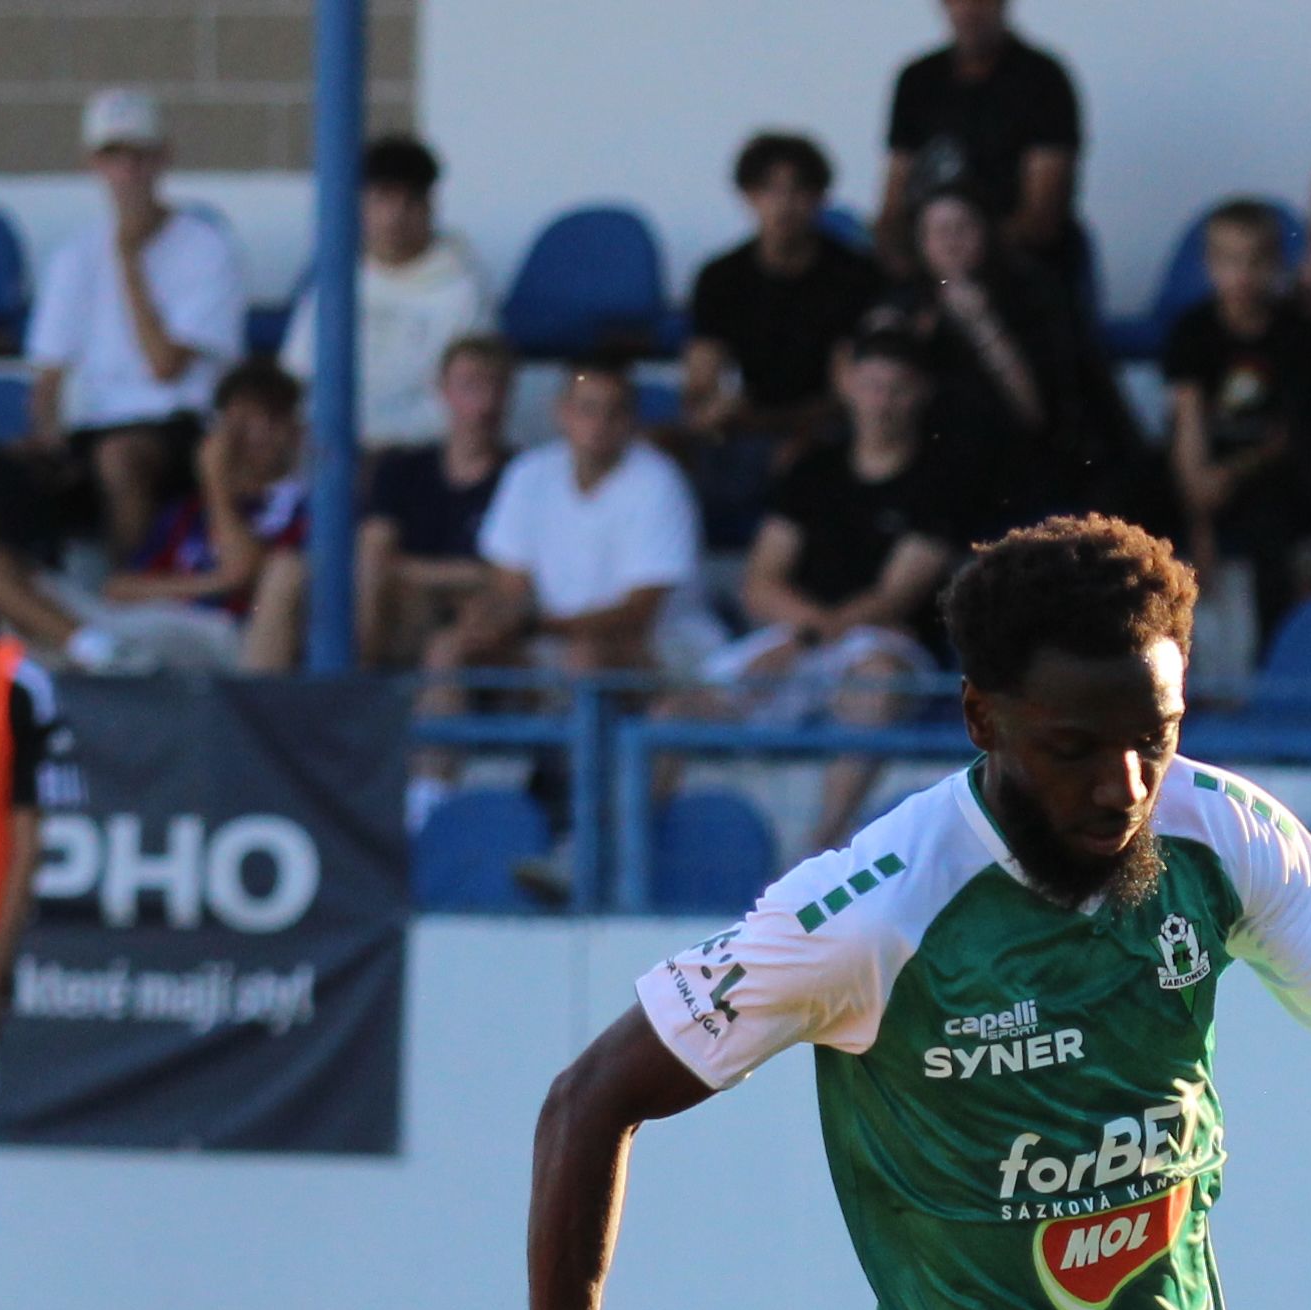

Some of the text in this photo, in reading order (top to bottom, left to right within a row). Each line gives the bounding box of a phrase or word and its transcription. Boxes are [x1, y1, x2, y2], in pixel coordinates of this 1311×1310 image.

[1162, 965, 1209, 987] JABLONEC
[945, 1000, 1038, 1039] capelli
[988, 1024, 1038, 1040] SPORT
[924, 1028, 1085, 1079] SYNER
[1002, 1191, 1111, 1221] SÁZKOVÁ
[1060, 1212, 1151, 1270] MOL
